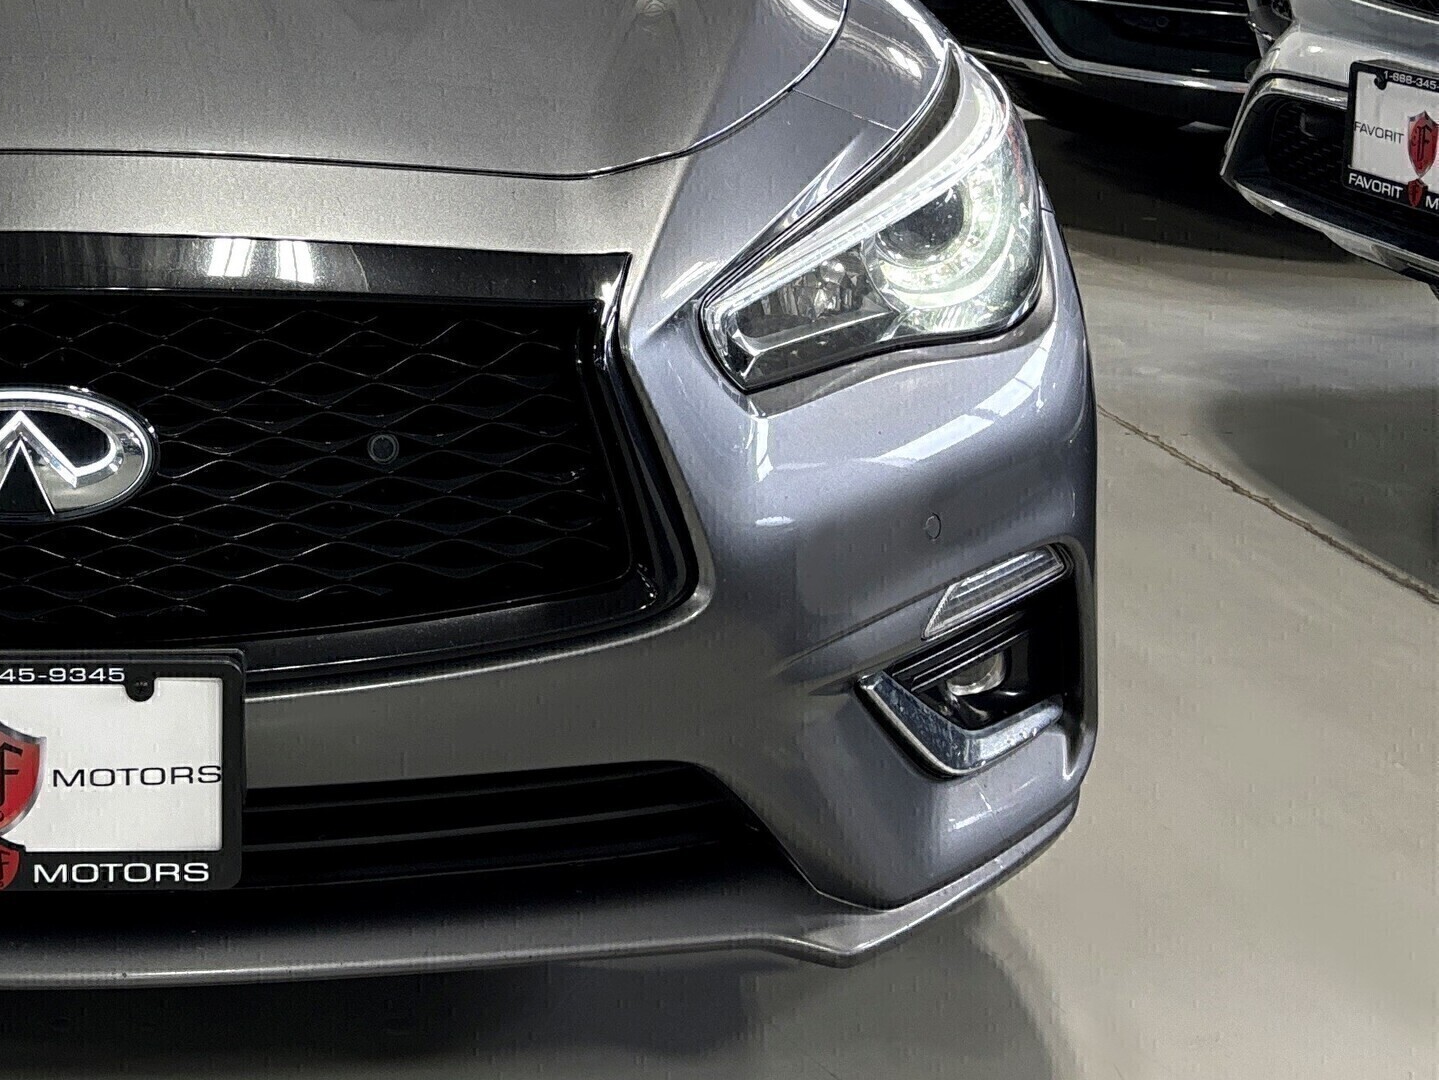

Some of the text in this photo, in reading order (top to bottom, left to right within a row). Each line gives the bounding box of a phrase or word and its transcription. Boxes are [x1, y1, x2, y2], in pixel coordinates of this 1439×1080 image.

[1353, 120, 1404, 145] FAVORIT
[1348, 172, 1403, 199] FAVORIT
[52, 764, 223, 788] MOTORS
[33, 862, 210, 884] MOTORS
